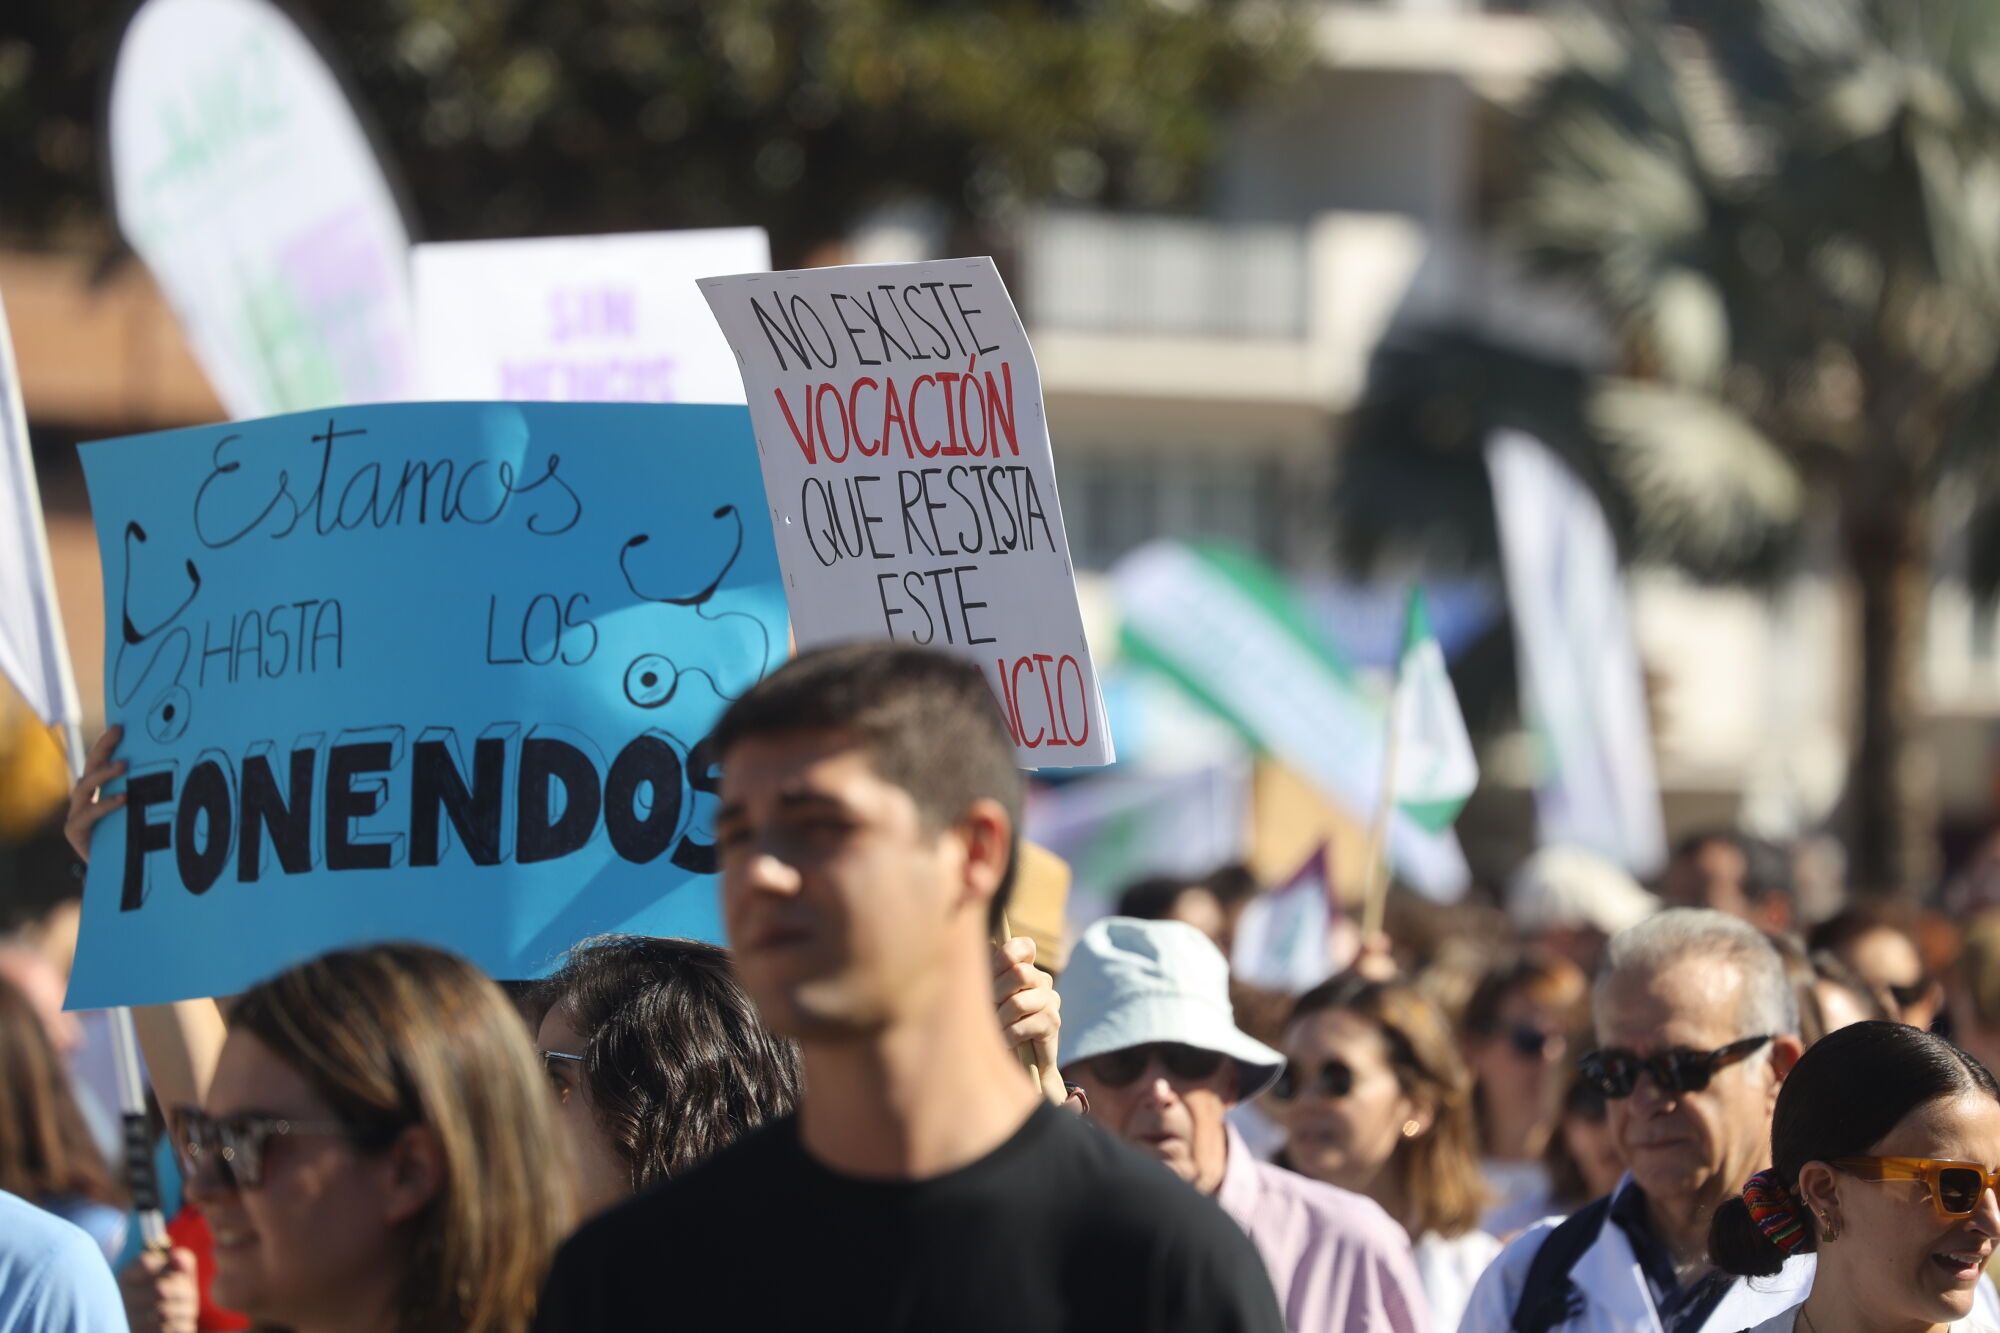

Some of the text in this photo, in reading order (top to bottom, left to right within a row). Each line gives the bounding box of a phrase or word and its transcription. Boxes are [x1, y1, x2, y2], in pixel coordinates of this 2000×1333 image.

[750, 282, 999, 371] NO EXISTE
[774, 353, 1019, 464] VOCACIÓN
[194, 419, 582, 549] Estamos
[801, 465, 1056, 566] QUE RESISTA
[199, 592, 599, 687] HASTA LOS
[877, 565, 997, 645] ESTE
[974, 653, 1089, 749] NCIO
